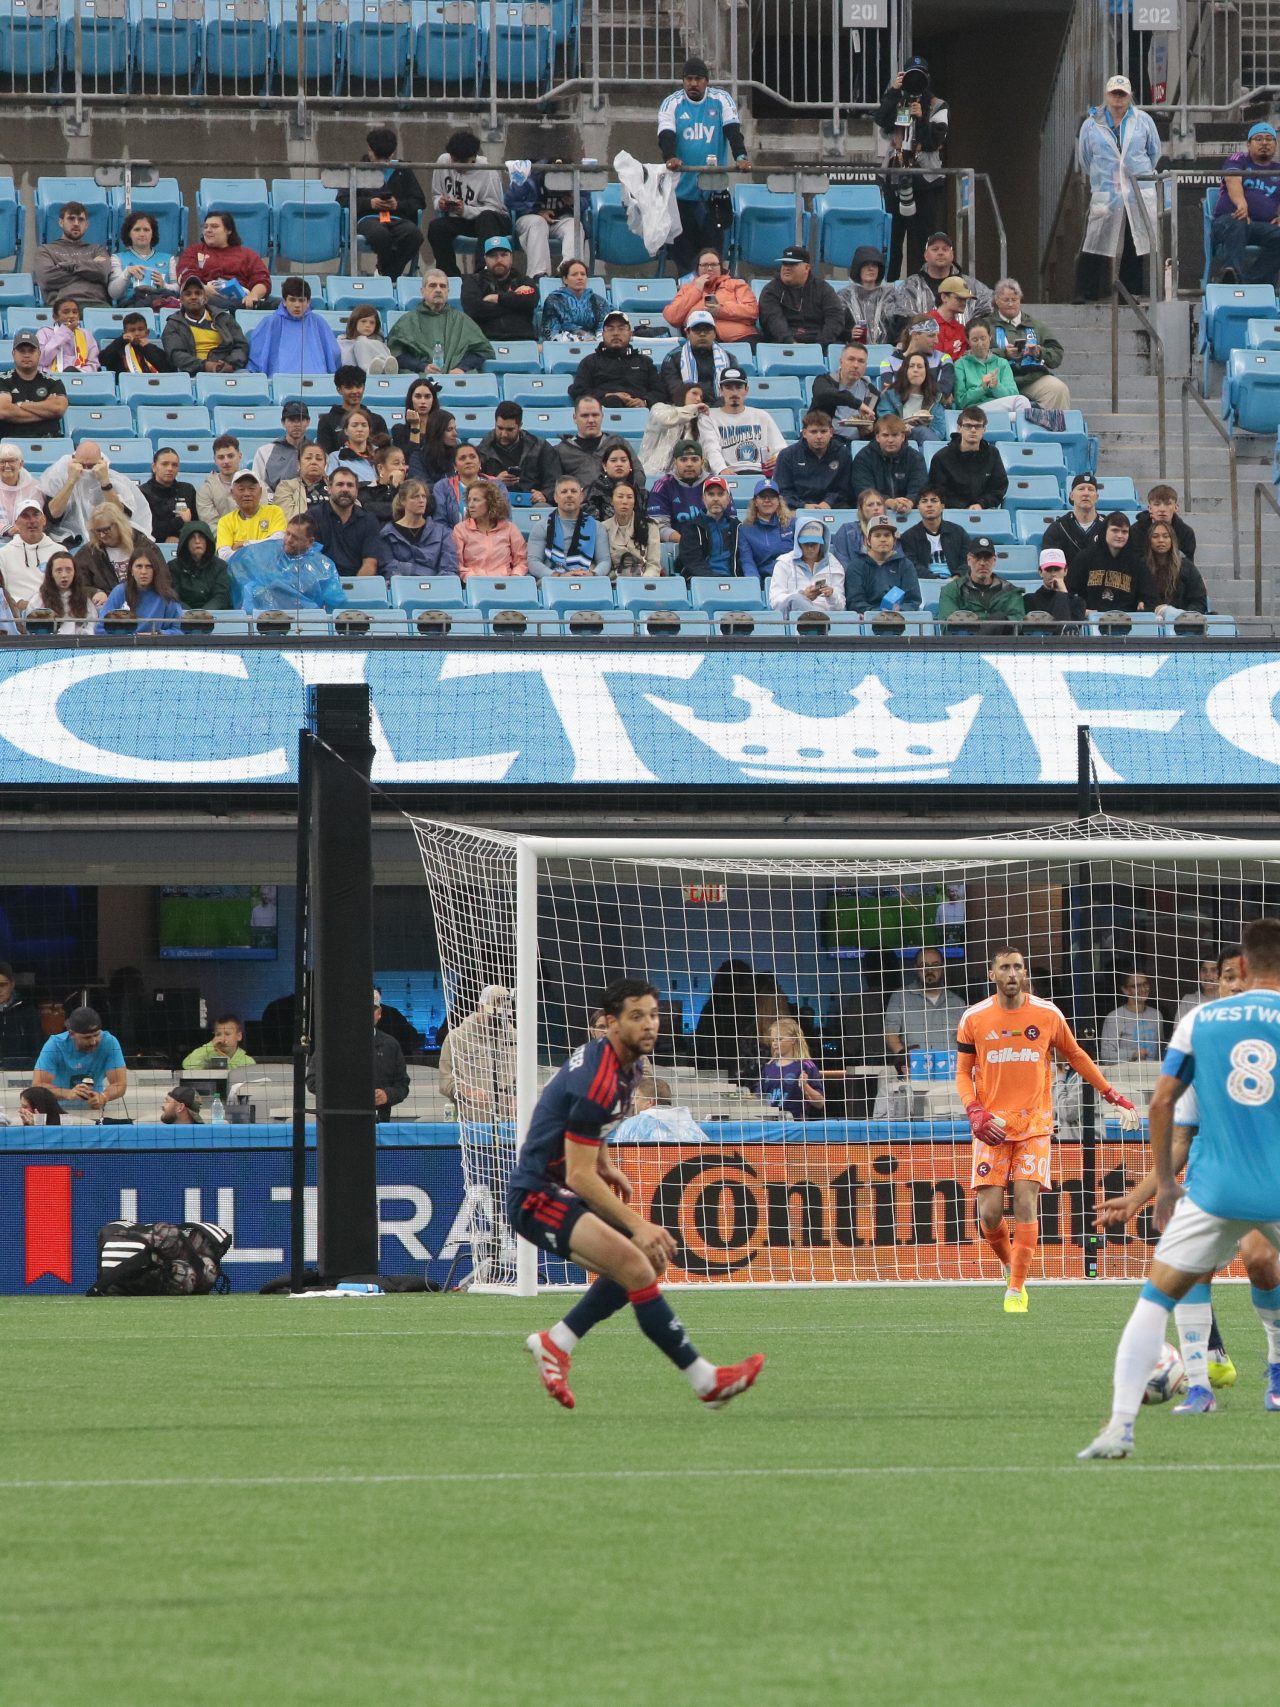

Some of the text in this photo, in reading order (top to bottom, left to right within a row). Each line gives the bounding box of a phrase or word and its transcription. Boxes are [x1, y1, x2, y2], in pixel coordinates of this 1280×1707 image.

[851, 4, 878, 21] 201
[1138, 7, 1171, 24] 202
[683, 122, 716, 144] ally
[1243, 178, 1277, 197] ally
[0, 650, 704, 783] CLT
[987, 1047, 1040, 1064] Gillette
[1226, 1039, 1277, 1107] 8
[1022, 1154, 1048, 1176] 30
